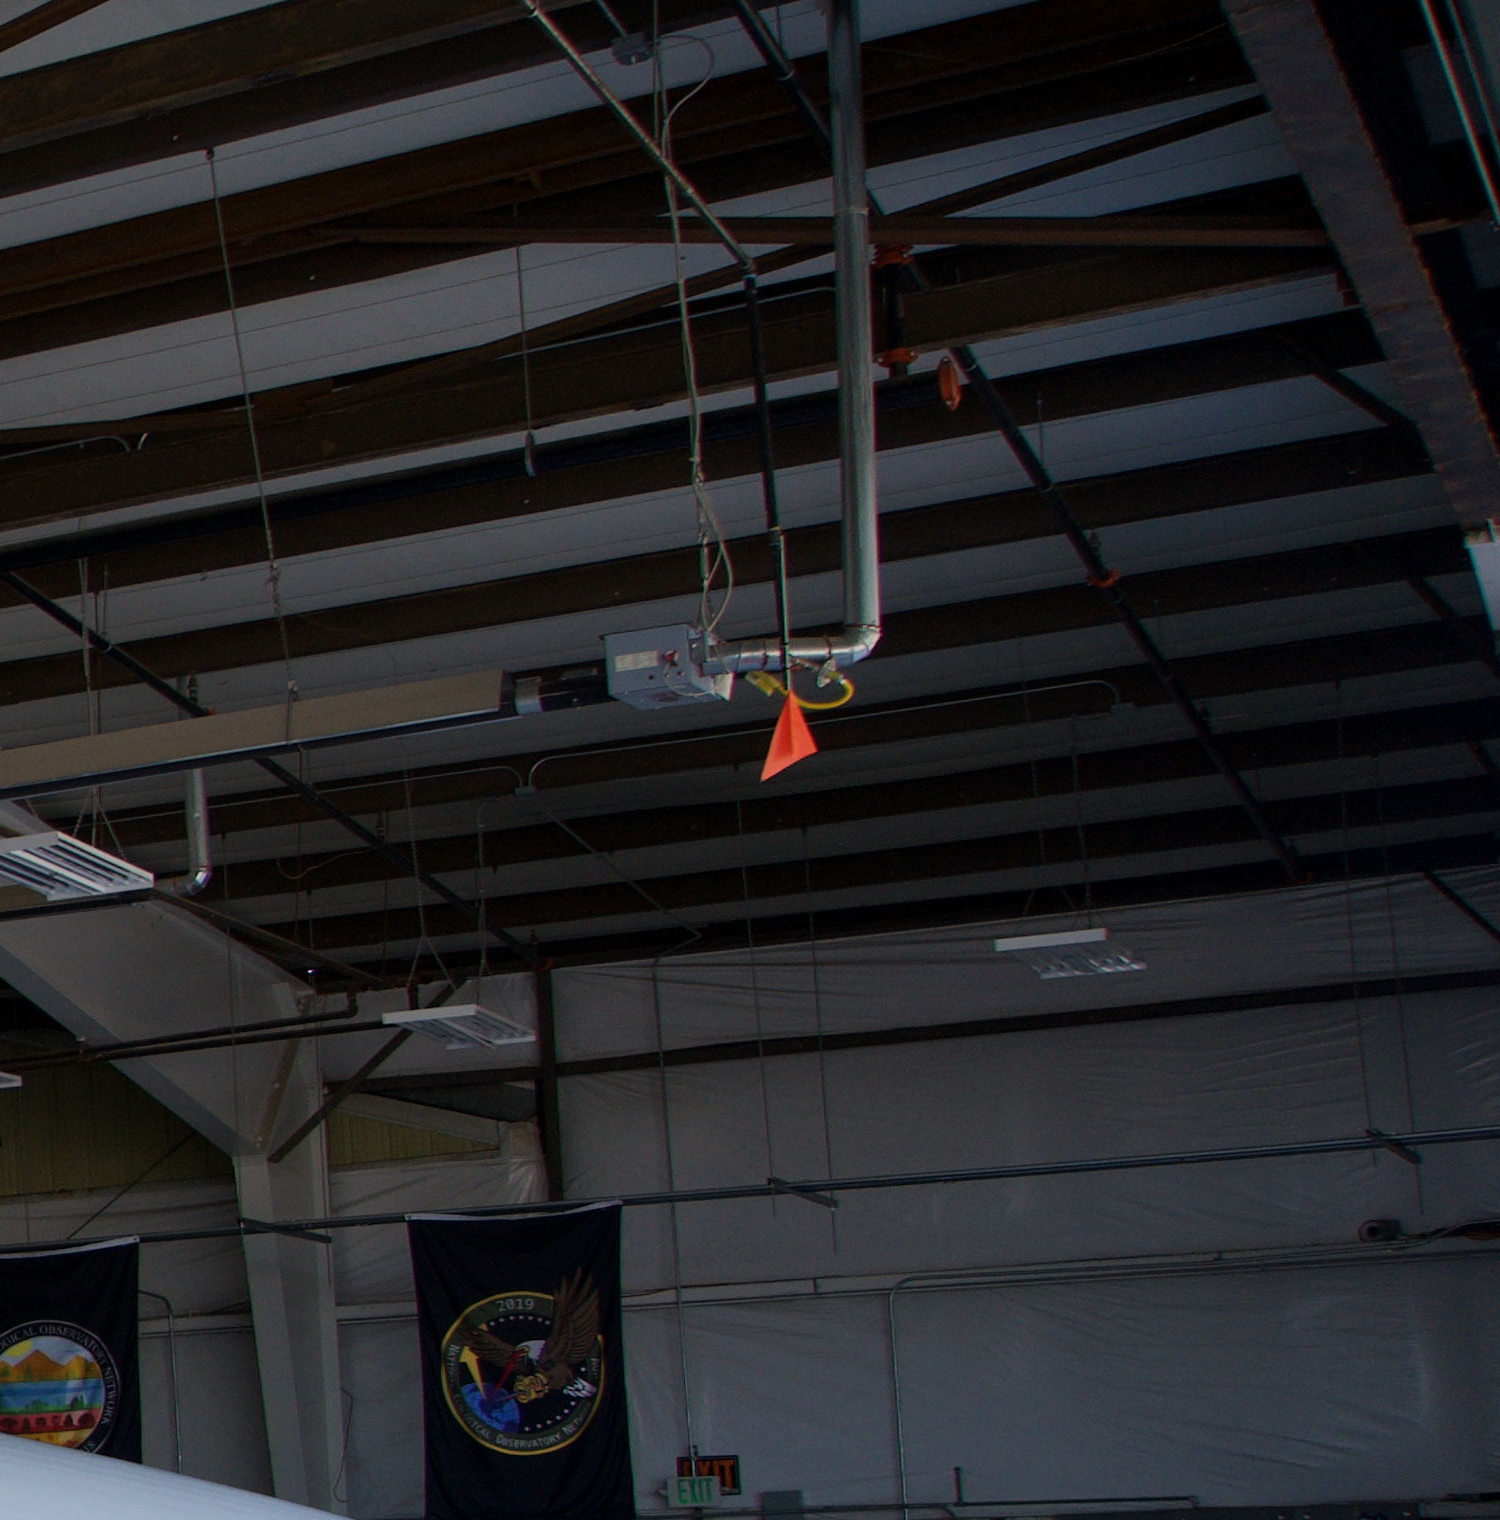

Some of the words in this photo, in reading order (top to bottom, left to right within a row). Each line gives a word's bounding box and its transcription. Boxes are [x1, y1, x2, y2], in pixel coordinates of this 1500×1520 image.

[496, 1299, 535, 1312] 2019
[38, 1324, 108, 1367] OBSERVATORY
[101, 1367, 117, 1426] NETWORK
[495, 1432, 561, 1449] OBSERVATORY
[678, 1479, 713, 1504] EXIT
